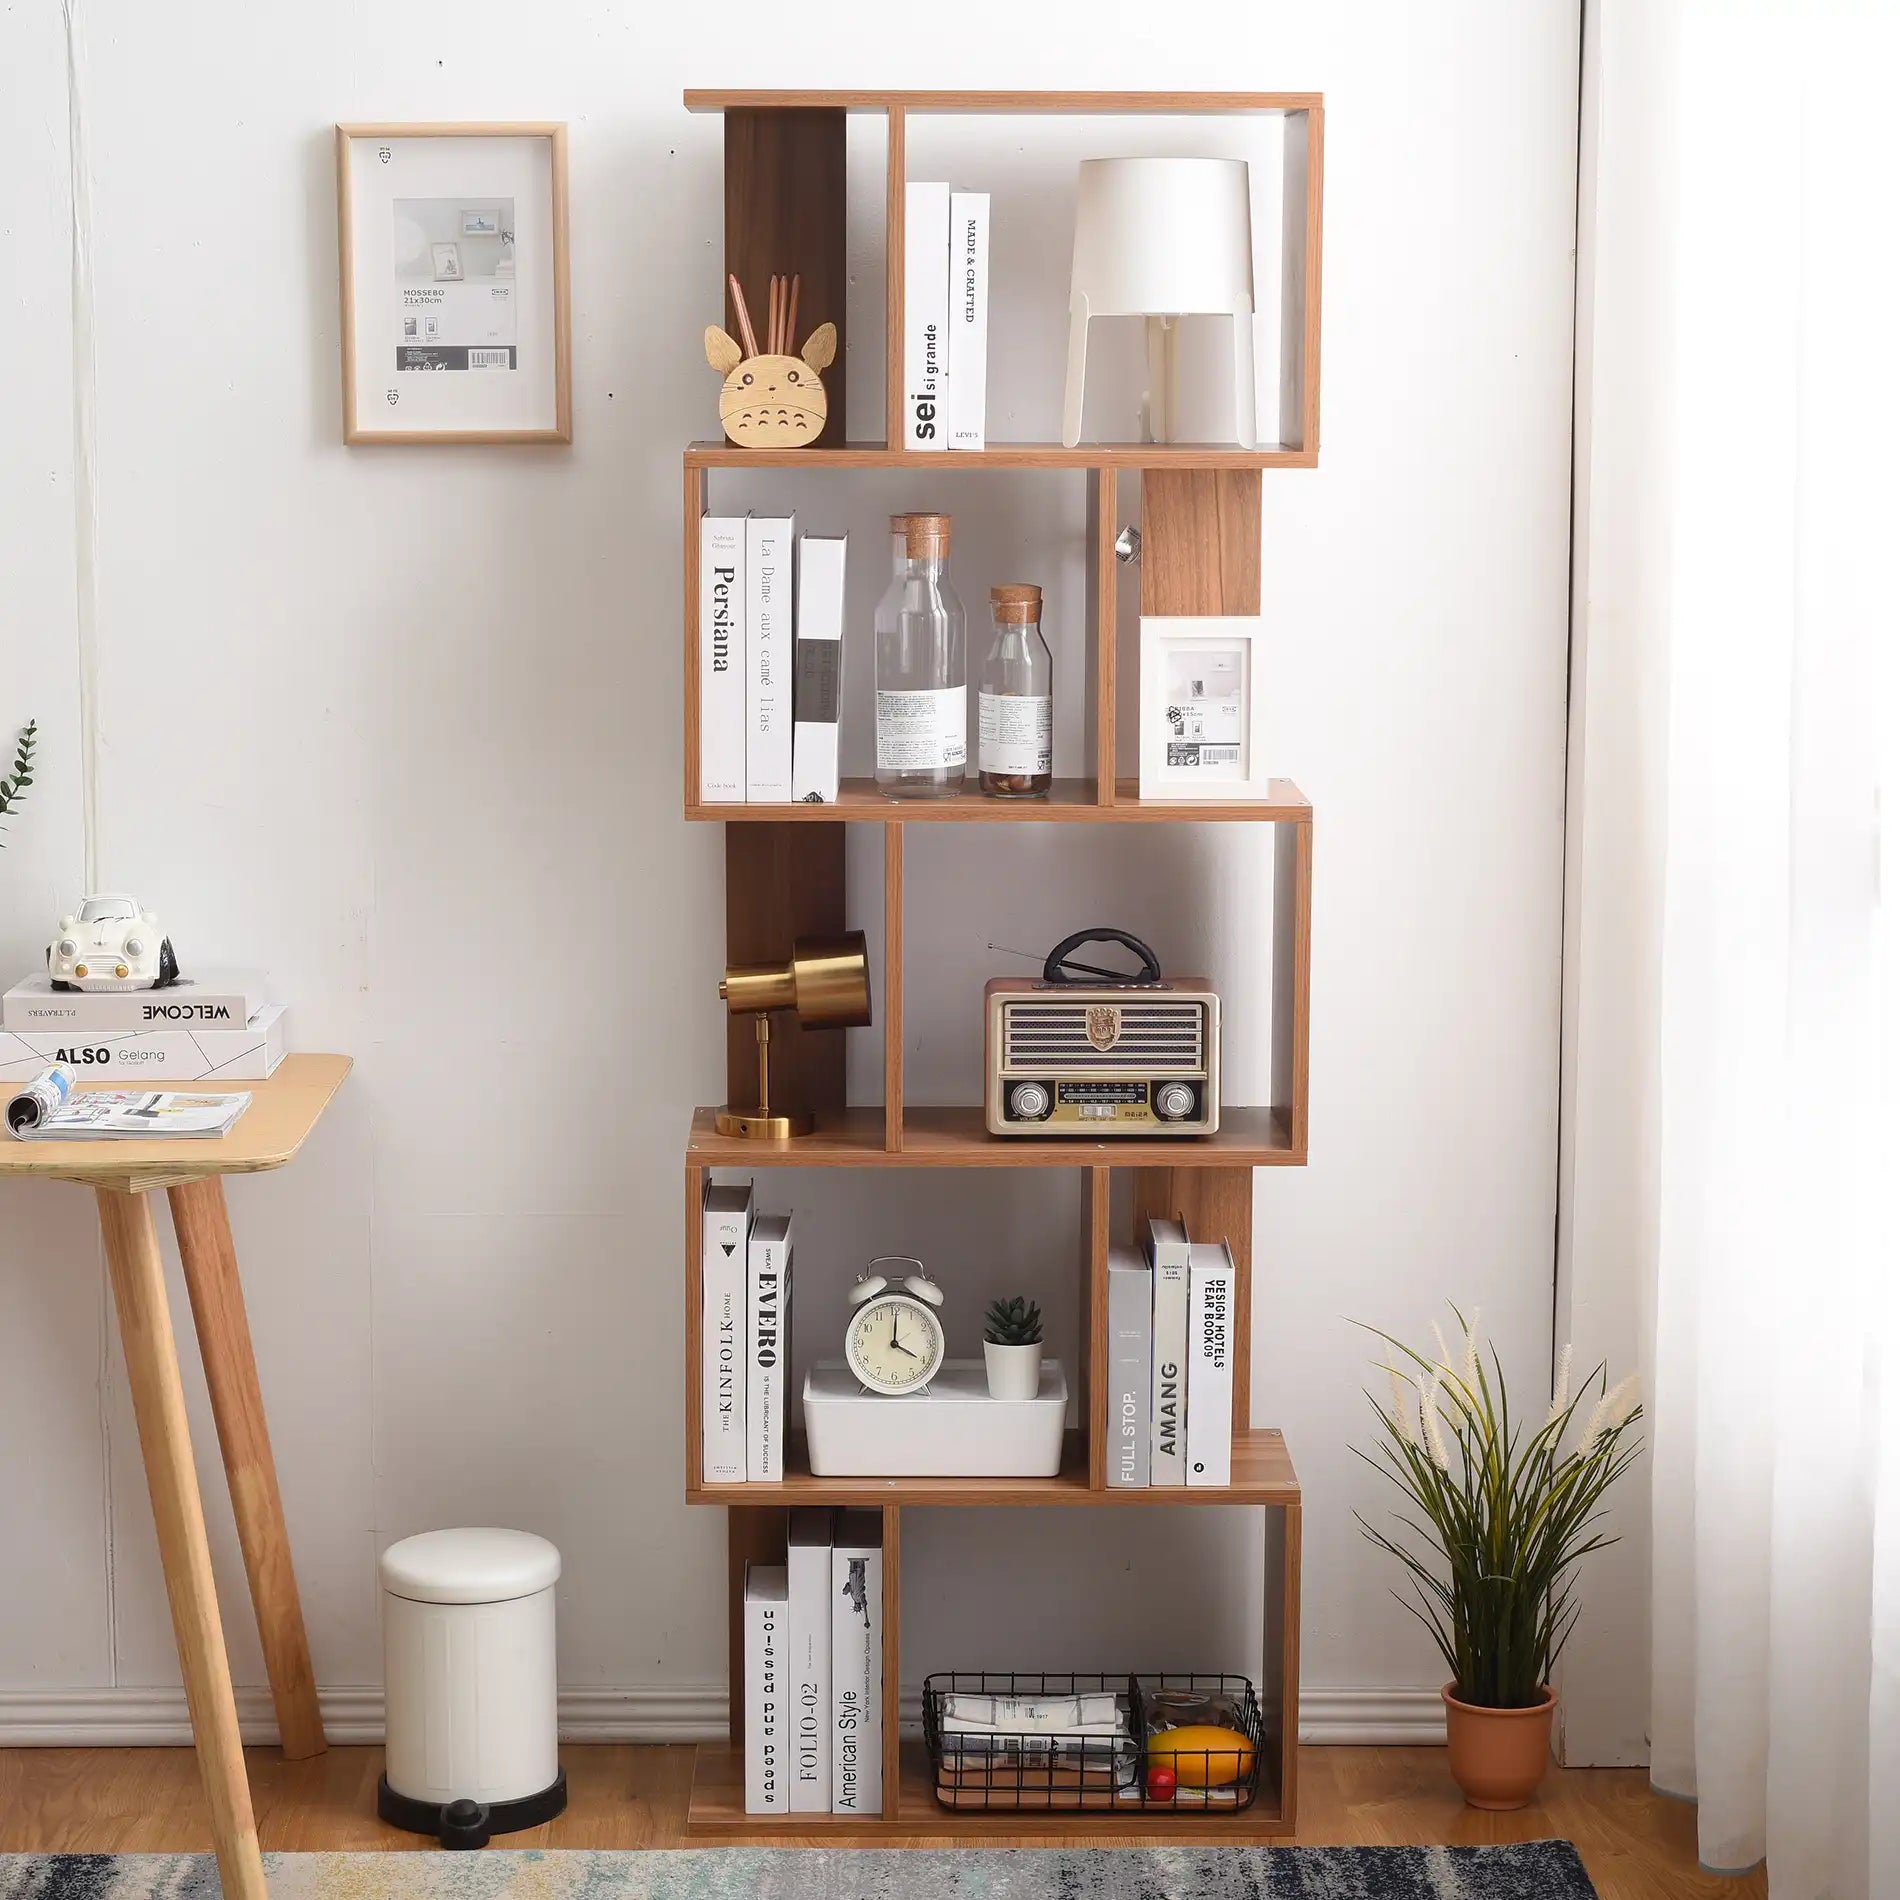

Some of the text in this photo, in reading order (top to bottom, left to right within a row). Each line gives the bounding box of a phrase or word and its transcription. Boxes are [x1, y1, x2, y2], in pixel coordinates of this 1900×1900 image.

[966, 219, 976, 323] MADE & CRAFTED
[403, 288, 445, 297] MOSSEBO
[910, 394, 936, 440] sei
[713, 566, 735, 673] Persiana
[760, 538, 776, 733] La Dame aux camé lias
[143, 1005, 230, 1019] WELCOME
[55, 1048, 165, 1064] ALSO Gelang
[1204, 1280, 1215, 1308] YEAR
[1215, 1280, 1226, 1320] DESIGN
[758, 1272, 778, 1368] EVERO
[875, 1312, 884, 1321] 11
[909, 1312, 913, 1320] 1
[862, 1324, 873, 1333] 10
[920, 1324, 927, 1332] 2
[858, 1339, 864, 1348] 9
[926, 1340, 932, 1348] 3
[719, 1320, 733, 1412] KINFOLK
[863, 1355, 869, 1364] 8
[920, 1355, 926, 1365] 4
[876, 1366, 882, 1375] 7
[891, 1371, 897, 1380] 6
[909, 1368, 915, 1376] 5
[1160, 1363, 1178, 1456] AMANG
[762, 1434, 768, 1442] OF
[1122, 1390, 1136, 1482] FULL STOP.
[764, 1610, 774, 1803] speed and passion
[800, 1682, 818, 1783] FOLIO-02
[838, 1691, 861, 1808] American Style
